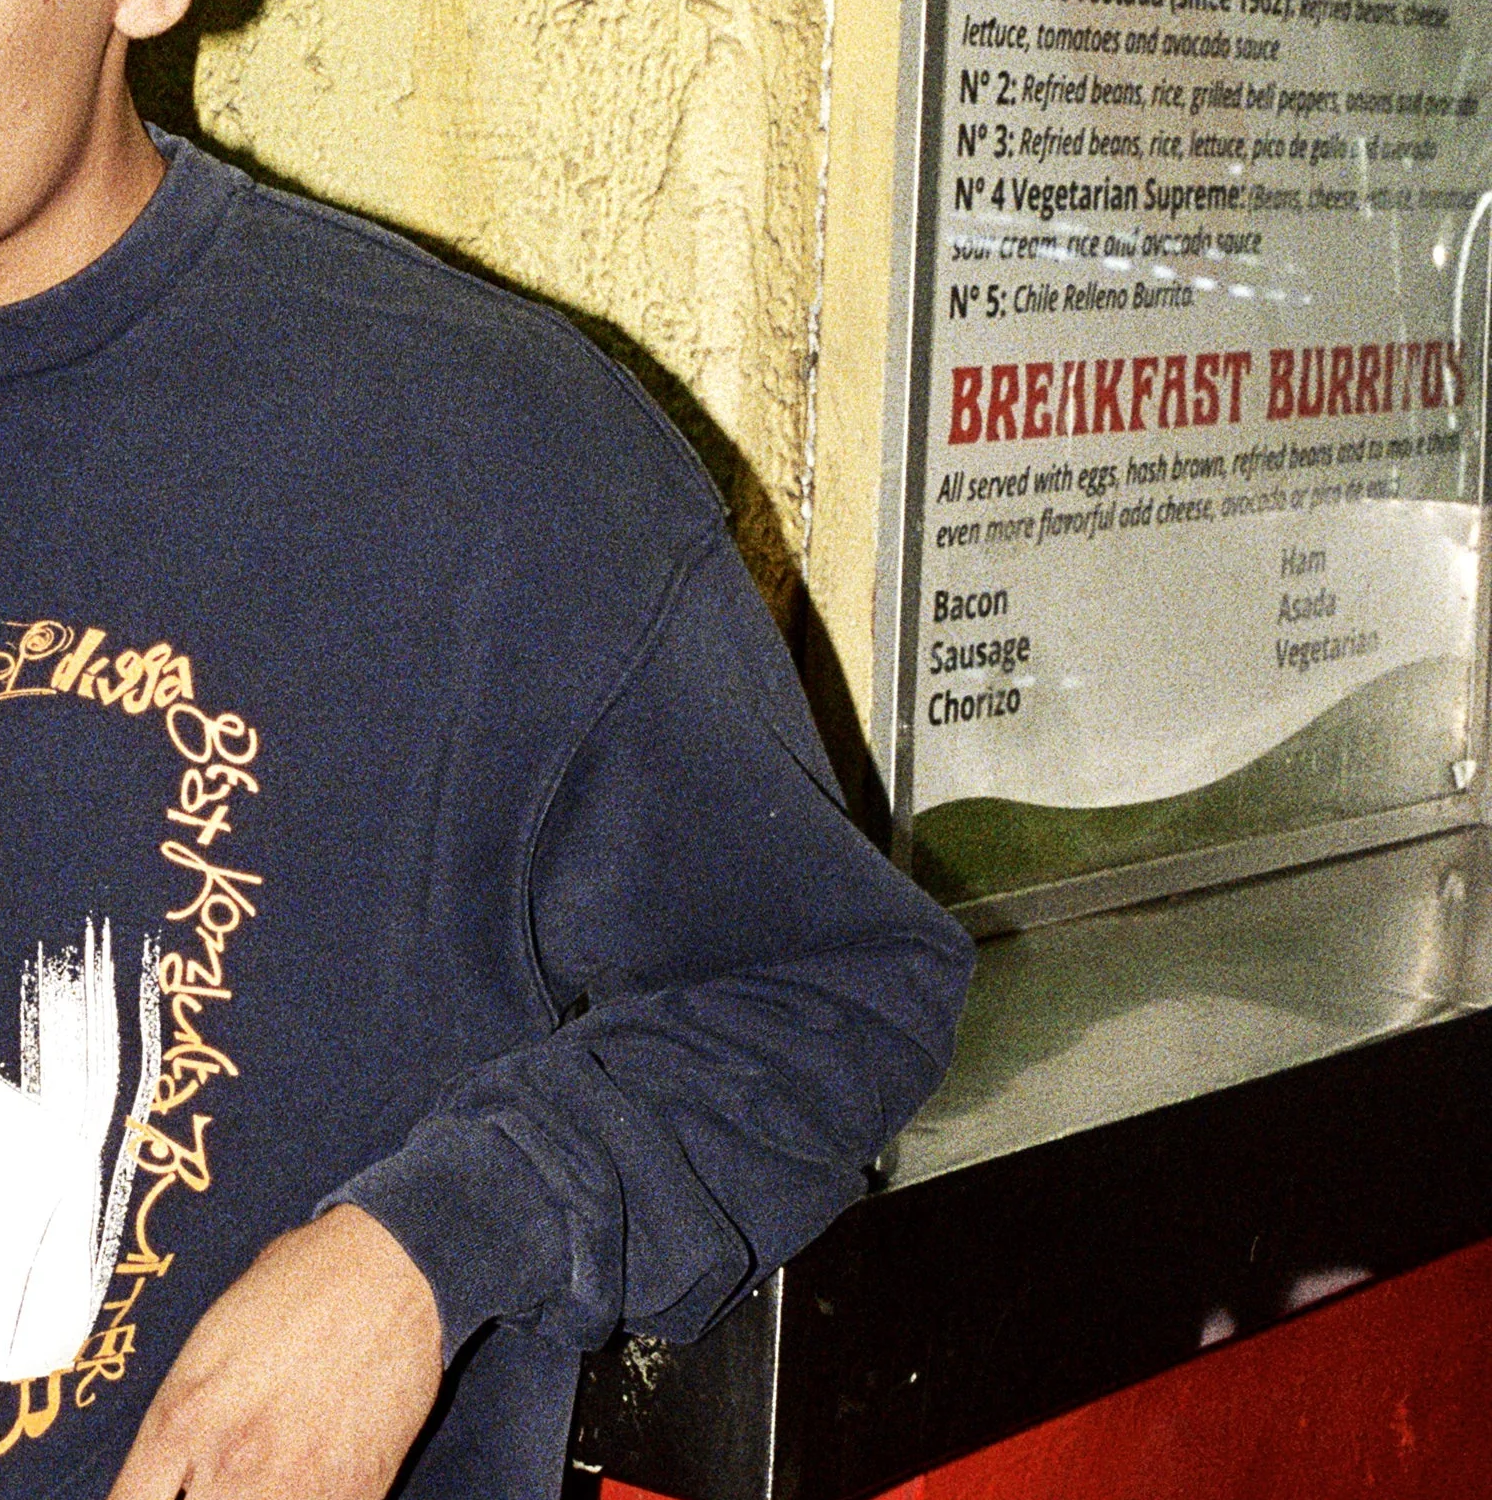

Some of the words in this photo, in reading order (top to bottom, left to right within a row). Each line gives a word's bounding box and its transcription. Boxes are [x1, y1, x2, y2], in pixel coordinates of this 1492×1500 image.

[963, 16, 1029, 52] lettuce,
[1038, 25, 1121, 54] tomatoes
[996, 71, 1016, 106] 2:
[1022, 73, 1088, 111] Refried
[994, 124, 1014, 159] 3:
[1020, 126, 1085, 163] Refried
[991, 178, 1005, 210] 4
[1012, 177, 1138, 221] Vegetarian
[1144, 178, 1246, 219] Supreme:
[986, 284, 1006, 318] 5:
[1013, 284, 1059, 314] Chile
[949, 351, 1252, 444] BREAKFAST
[1267, 340, 1470, 419] BURRITOS
[937, 473, 964, 503] All
[967, 466, 1030, 502] served
[1034, 465, 1073, 493] with
[936, 522, 981, 549] even
[1037, 502, 1116, 545] flavorful
[933, 590, 1008, 624] Bacon
[930, 636, 1030, 675] Sausage
[928, 688, 1021, 726] Chorizo
